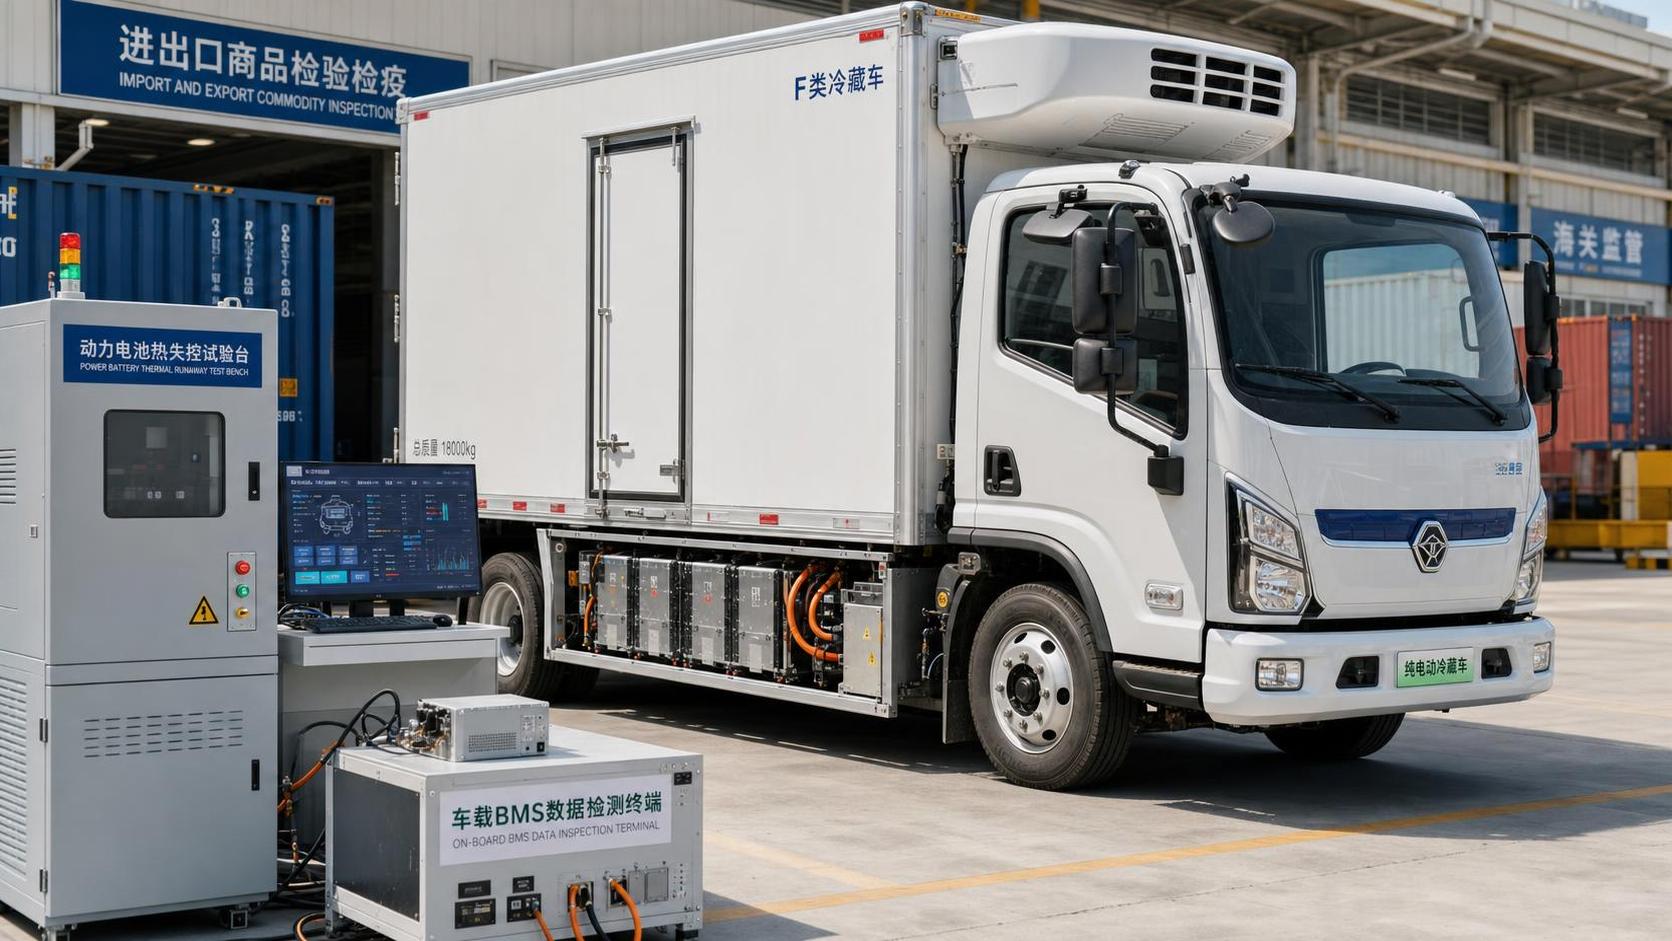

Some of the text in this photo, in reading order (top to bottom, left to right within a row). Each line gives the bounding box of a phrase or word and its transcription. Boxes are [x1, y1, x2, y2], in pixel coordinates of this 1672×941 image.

[120, 24, 407, 98] 进出口商品检验检疫
[119, 72, 171, 92] IMPORT
[174, 79, 201, 96] AND
[205, 83, 254, 103] EXPORT
[256, 90, 326, 112] COMMODITY
[794, 64, 884, 101] F类冷藏车
[1553, 220, 1643, 265] 海关监管
[80, 339, 249, 364] 动力电池热失控试验台
[80, 362, 108, 371] POWER
[108, 363, 139, 373] BATTERY
[141, 365, 173, 374] THERMAL
[209, 367, 226, 375] TEST
[226, 368, 249, 376] BENCH
[441, 440, 476, 460] 18000kg
[1404, 657, 1468, 677] 纯电动冷藏车
[452, 791, 662, 830] 车载BMS数据检测终端
[452, 820, 661, 849] ON-BOARD BMS DATA INSPECTION TERMINAL
